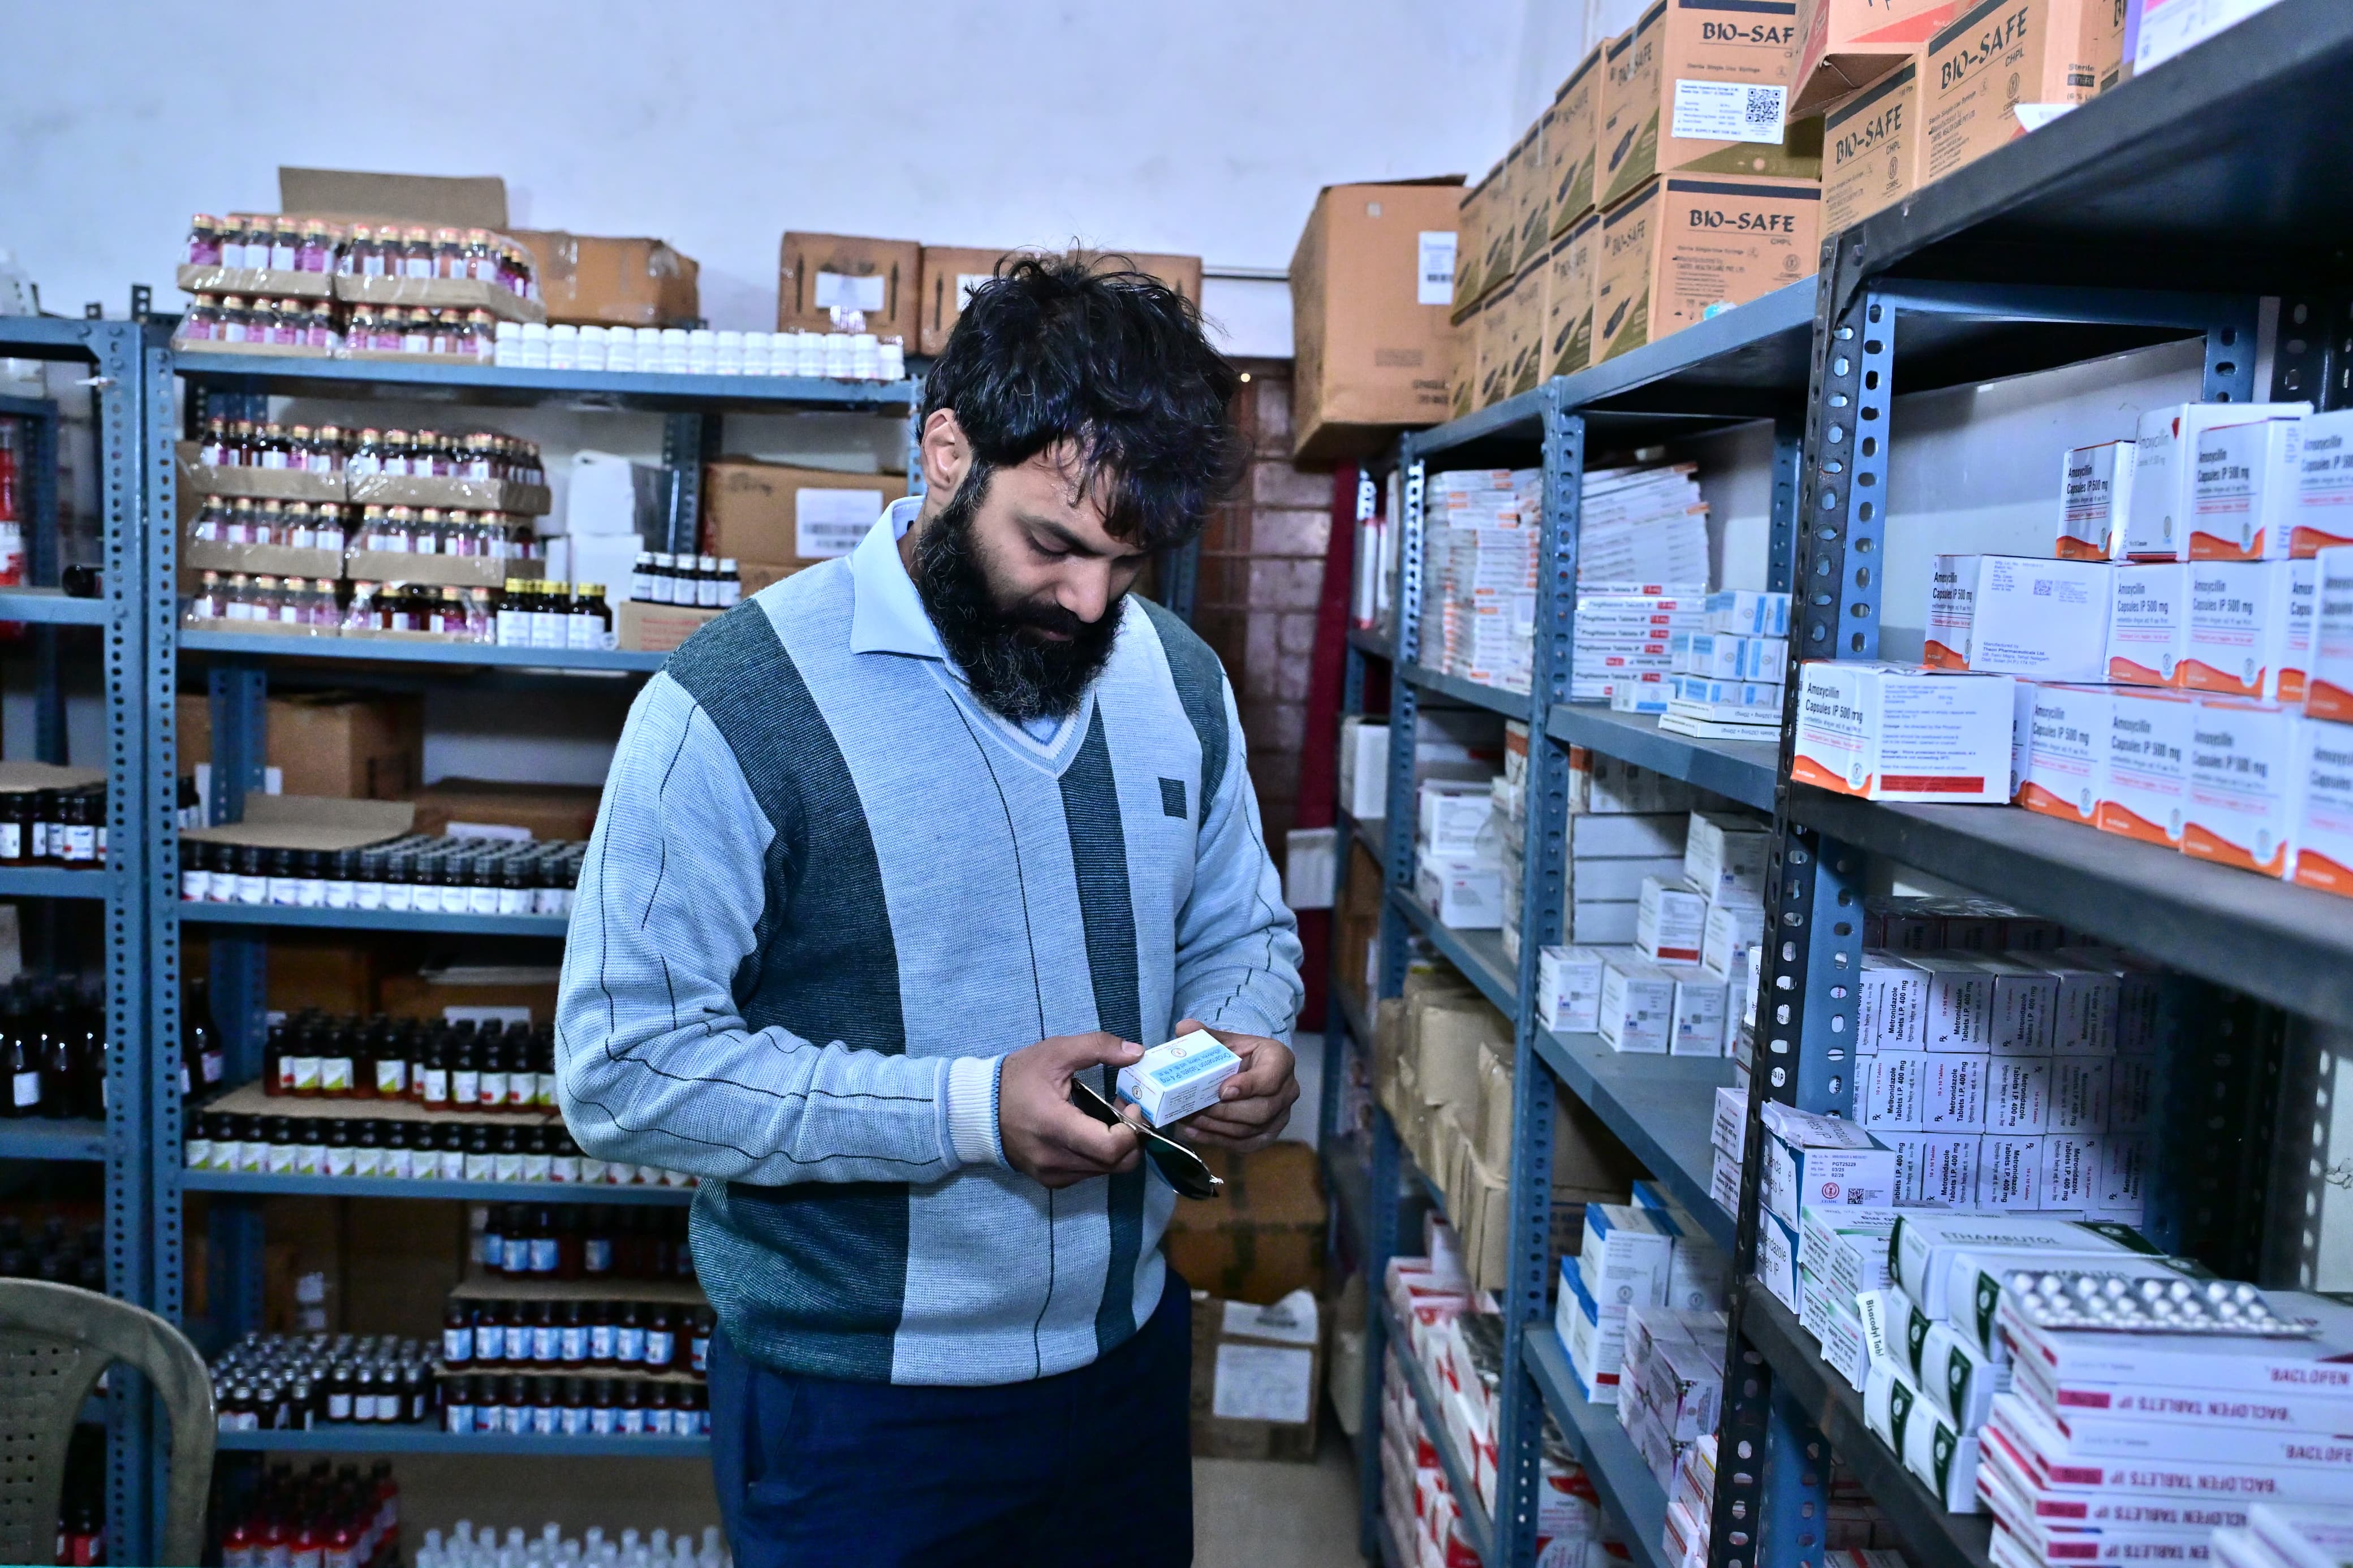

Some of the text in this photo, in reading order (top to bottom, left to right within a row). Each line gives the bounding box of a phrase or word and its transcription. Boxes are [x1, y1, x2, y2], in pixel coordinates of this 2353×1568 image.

[1703, 22, 1795, 44] BIO-SAF
[1941, 6, 2028, 90] BIO-SAFE
[2005, 47, 2024, 67] CHPL
[2068, 63, 2095, 72] Sterile
[1836, 103, 1902, 165] BIO-SAFE
[1886, 140, 1901, 155] CHPL
[1689, 209, 1795, 232] BIO-SAFE
[2067, 482, 2086, 496] Capsules
[2087, 481, 2092, 492] IP
[2101, 480, 2108, 492] mg
[1934, 572, 1957, 585] Amoxycillin
[1933, 588, 1952, 602] Capsules
[1953, 588, 1957, 599] IP
[1966, 591, 1972, 602] mg
[2118, 601, 2139, 614] Capsules
[2147, 601, 2157, 612] 500
[2159, 602, 2168, 615] mg
[2243, 602, 2253, 615] mg
[1807, 683, 1839, 699] Amoxycillin
[1805, 699, 1863, 724] Capsules IP 500 mg
[1902, 980, 1908, 991] mg
[1967, 981, 1973, 992] mg
[1888, 987, 1898, 1034] Metronidazole
[1954, 988, 1962, 1035] Metronidazole
[1199, 1052, 1231, 1068] Ondansetron
[1900, 1060, 1907, 1071] mg
[1962, 1061, 1968, 1072] mg
[1180, 1065, 1200, 1075] Tablets
[1887, 1067, 1896, 1114] Metronidazole
[1949, 1068, 1958, 1115] Metronidazole
[2019, 1073, 2028, 1120] Metronidazole
[2009, 1116, 2015, 1127] mg
[1899, 1142, 1905, 1154] mg
[1954, 1142, 1960, 1153] mg
[1941, 1150, 1950, 1195] Metronidazole
[2011, 1150, 2020, 1195] Metronidazole
[2072, 1148, 2080, 1194] Metronidazole
[2001, 1191, 2007, 1203] mg
[2062, 1191, 2068, 1201] mg
[1941, 1231, 2061, 1244] ETHAMBUTOL
[1774, 1261, 1779, 1276] IP
[1866, 1299, 1881, 1338] Bisacodyl
[2270, 1368, 2350, 1385] BACLOFEN
[2117, 1396, 2289, 1420] BACLOFEN TABLETS IP
[2286, 1445, 2353, 1462] BACLOFE
[2110, 1471, 2275, 1493] BACLOFEN TABLETS IP
[2095, 1506, 2247, 1526] CLOFEN TABLETS IP
